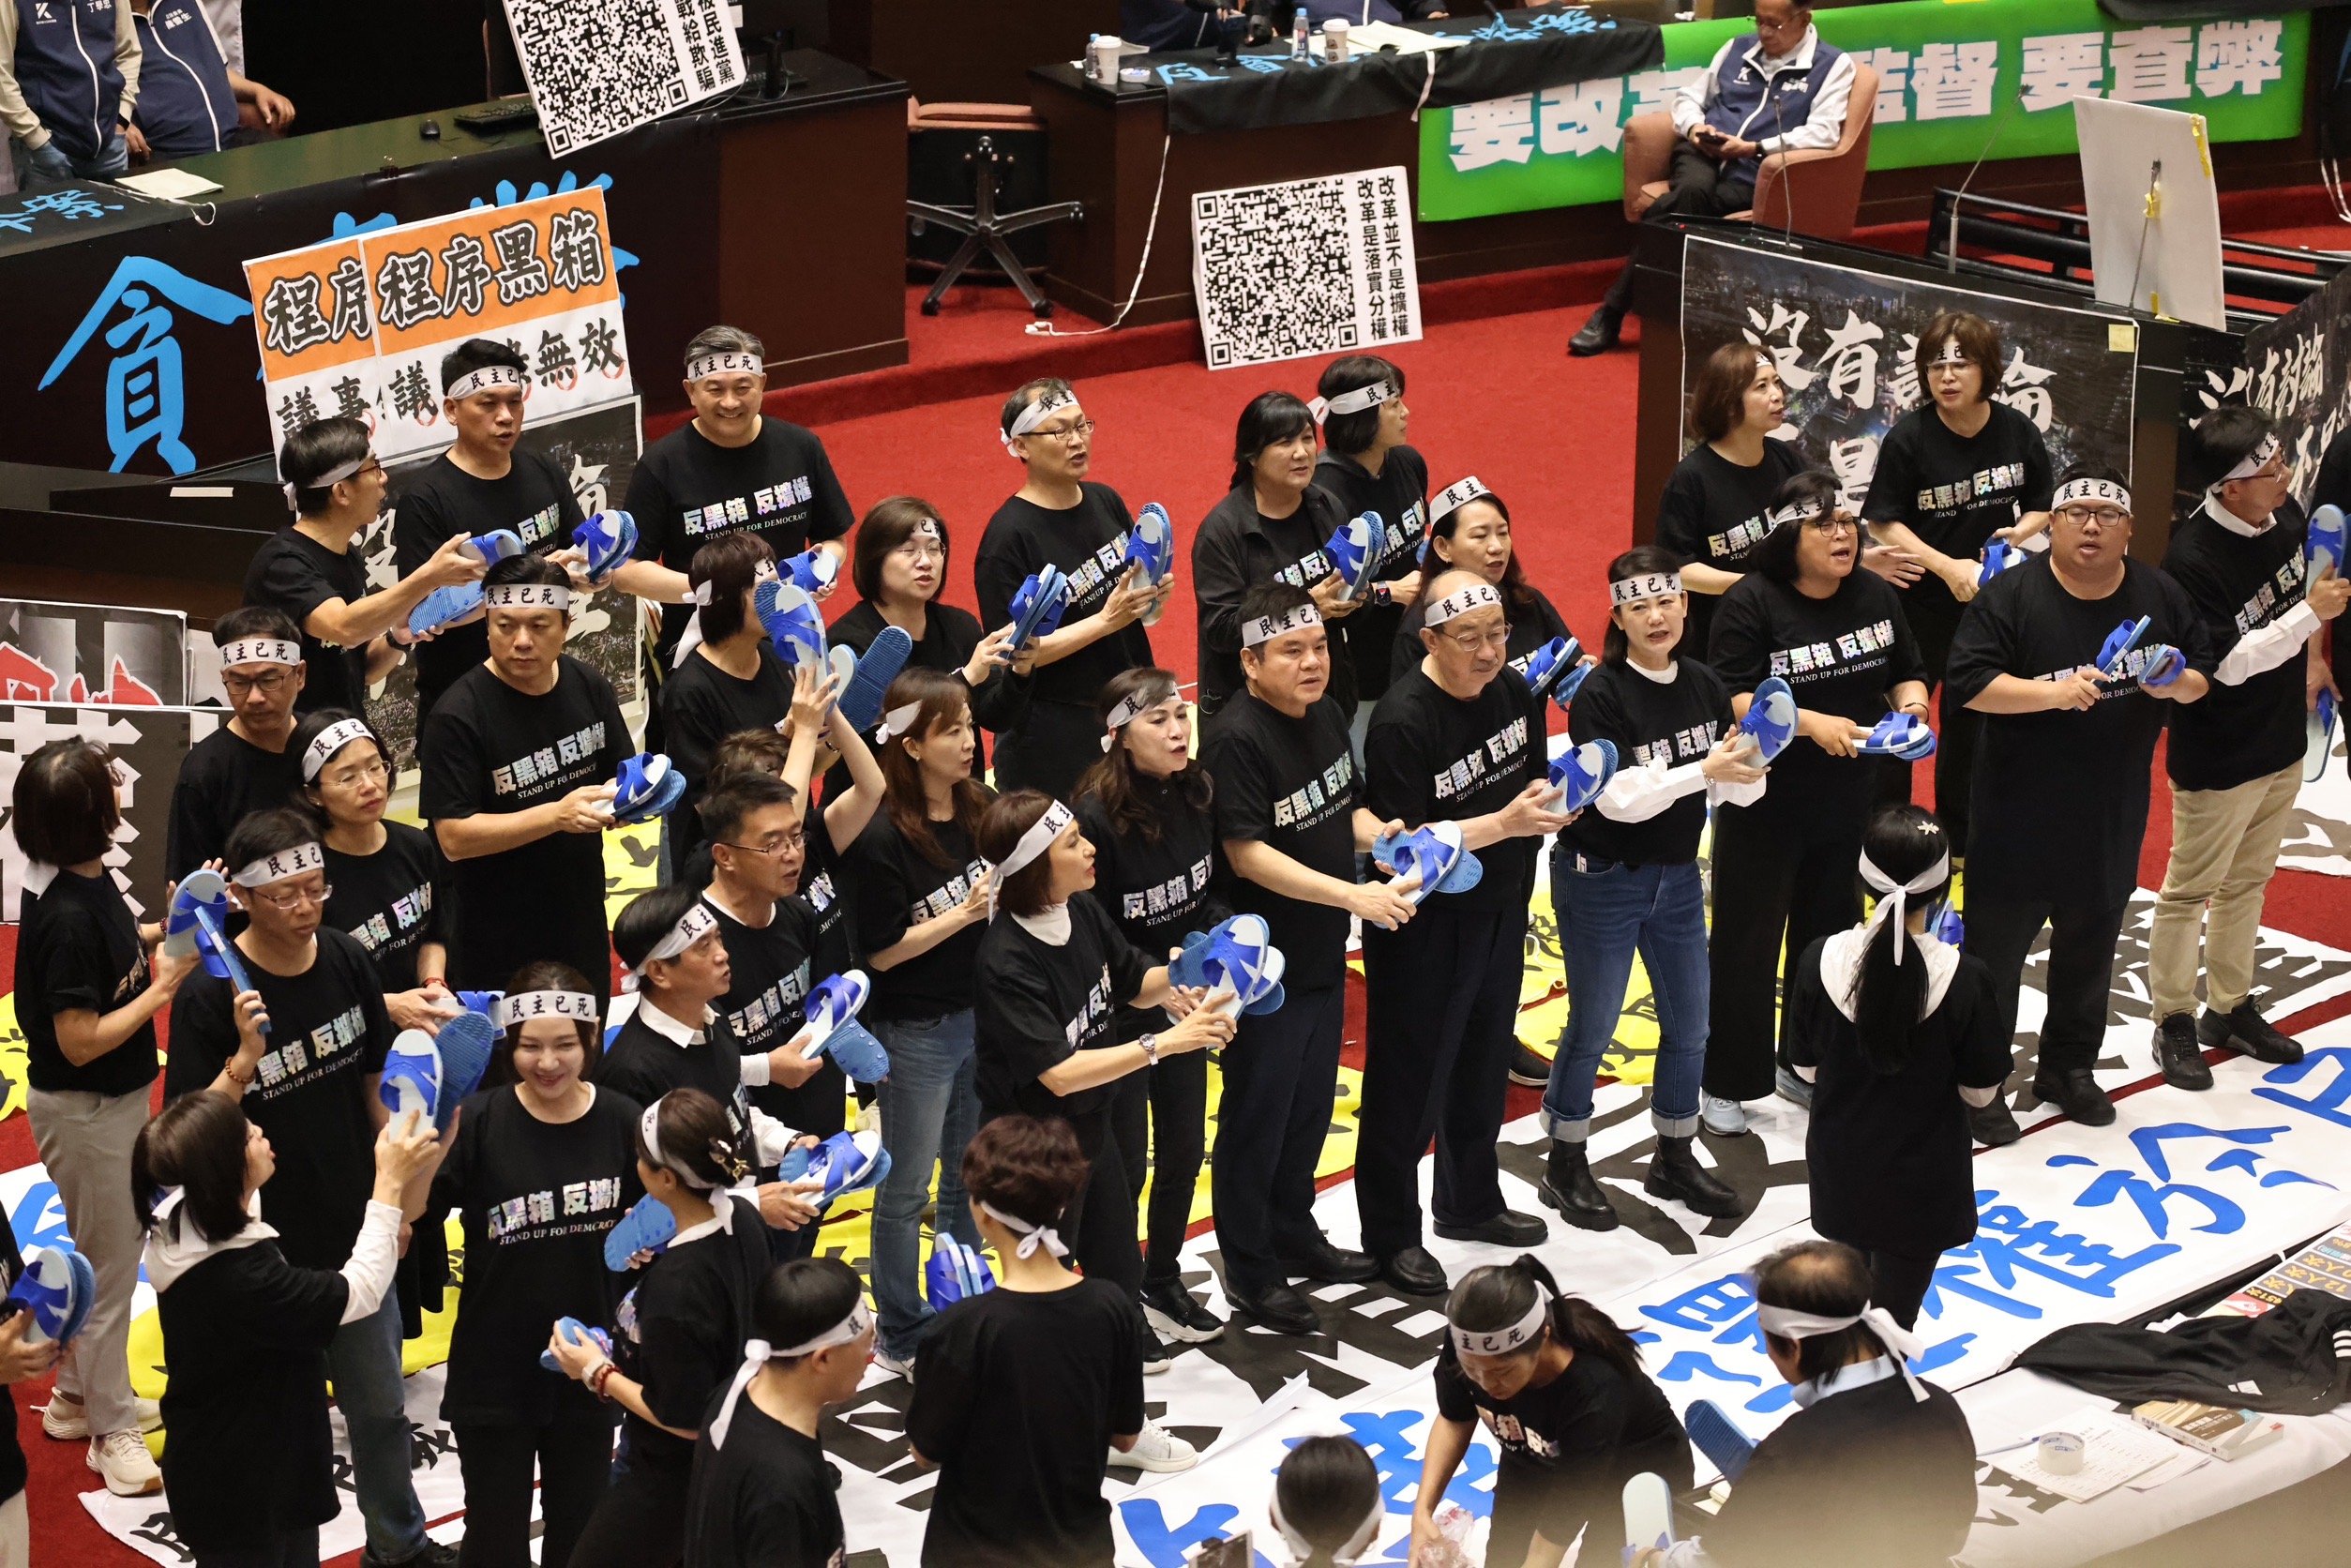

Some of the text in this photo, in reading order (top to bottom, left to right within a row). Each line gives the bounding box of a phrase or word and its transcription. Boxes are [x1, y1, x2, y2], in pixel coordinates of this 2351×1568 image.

[377, 208, 608, 330] 程序黑箱
[1358, 178, 1388, 341] 改革是落實分權
[1379, 175, 1409, 338] 改革並不是擴權
[694, 354, 754, 377] 民主已死
[2062, 481, 2126, 505] 民主已死
[683, 496, 748, 536] 反黑箱
[746, 522, 762, 533] FOR
[487, 586, 555, 606] 民主已死
[1614, 574, 1676, 601] 民主已死
[1770, 619, 1895, 677] 反黑箱 反擴權
[1789, 656, 1889, 685] STAND UP FOR DEMOCR
[491, 746, 559, 796] 反黑箱
[1485, 773, 1501, 785] FOR
[518, 784, 544, 799] STAND
[545, 779, 555, 791] UP
[1273, 779, 1325, 827] 反黑箱
[1296, 816, 1318, 832] STAND
[1123, 875, 1188, 920] 反黑箱
[348, 912, 392, 952] 黑箱
[388, 938, 407, 951] FOR
[512, 995, 591, 1020] 民主已死
[746, 1028, 774, 1046] STAND
[263, 1082, 293, 1101] STAND
[294, 1077, 306, 1088] UP
[307, 1068, 324, 1082] FOR
[488, 1190, 555, 1241] 反黑箱
[500, 1230, 531, 1245] STAND
[533, 1228, 548, 1239] UP
